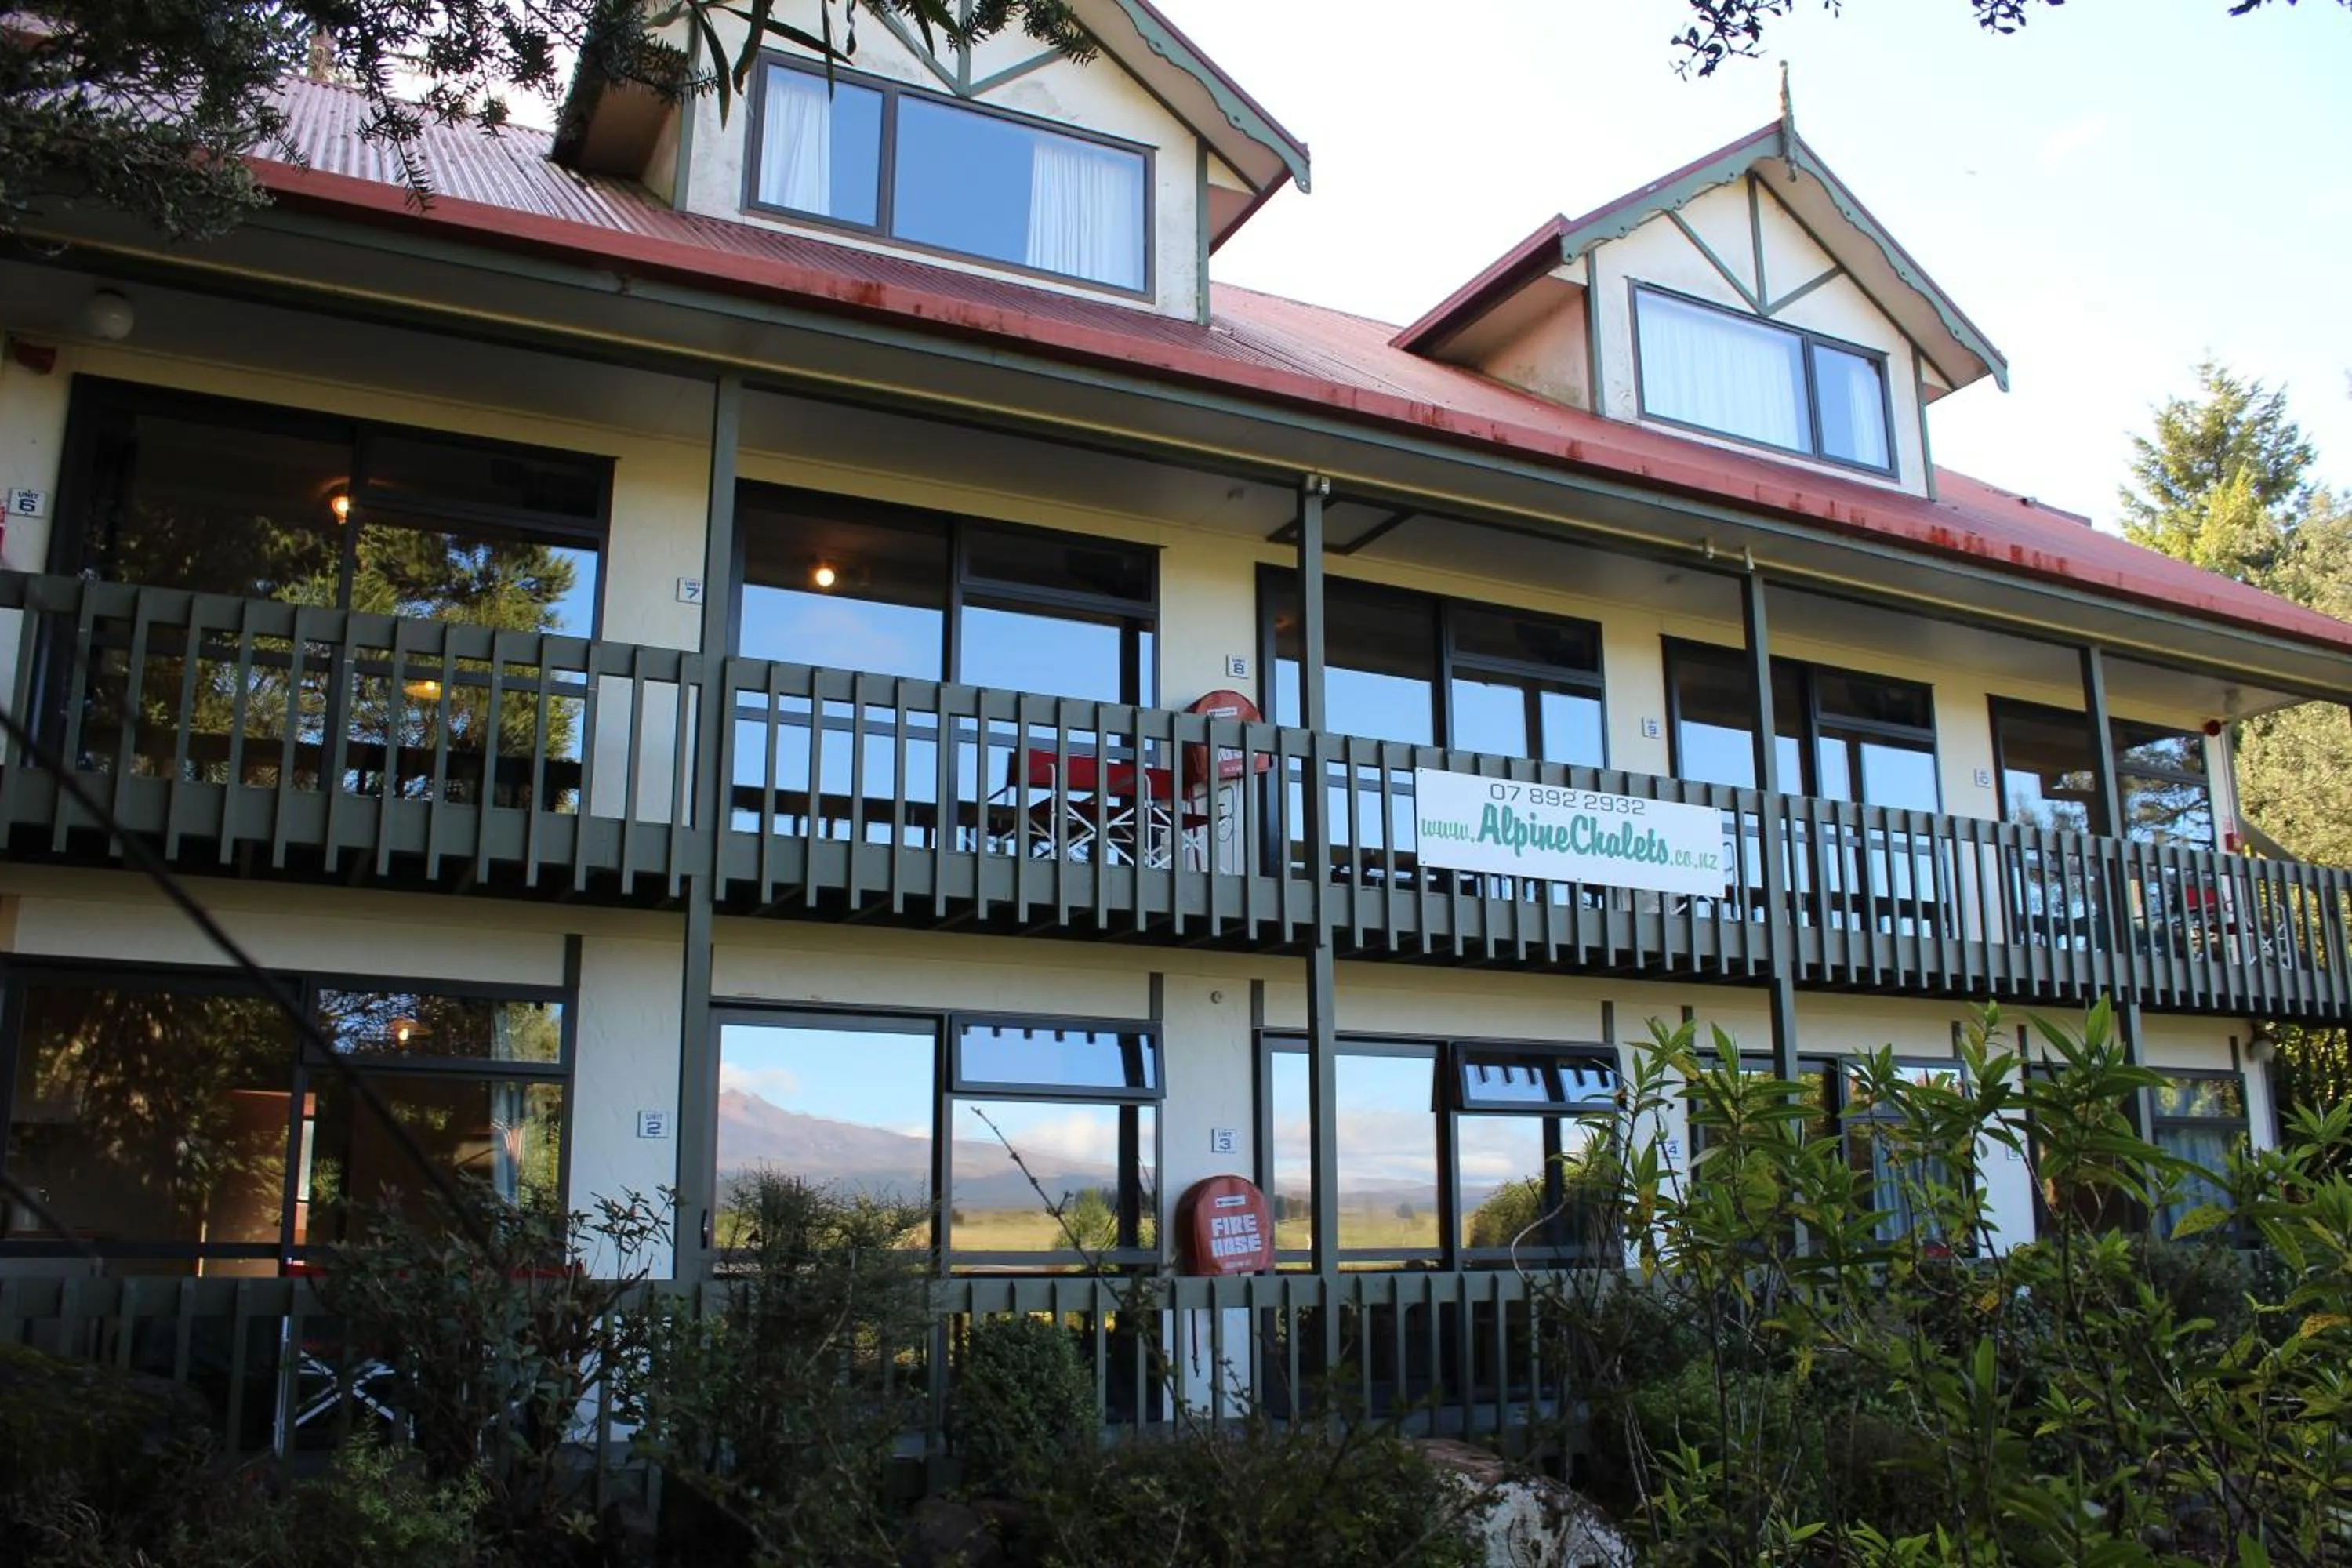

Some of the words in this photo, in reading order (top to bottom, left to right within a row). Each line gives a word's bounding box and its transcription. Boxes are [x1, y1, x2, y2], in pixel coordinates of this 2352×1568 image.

[19, 498, 36, 512] 6
[686, 587, 699, 599] 7
[1233, 662, 1244, 675] 8
[1490, 783, 1521, 801] 07
[1530, 788, 1577, 808] 892
[1584, 793, 1646, 816] 2932
[646, 1121, 662, 1134] 2
[1218, 1138, 1231, 1150] 3
[1668, 1145, 1678, 1154] 4
[1211, 1214, 1257, 1237] FIRE
[1211, 1233, 1262, 1258] HOSE
